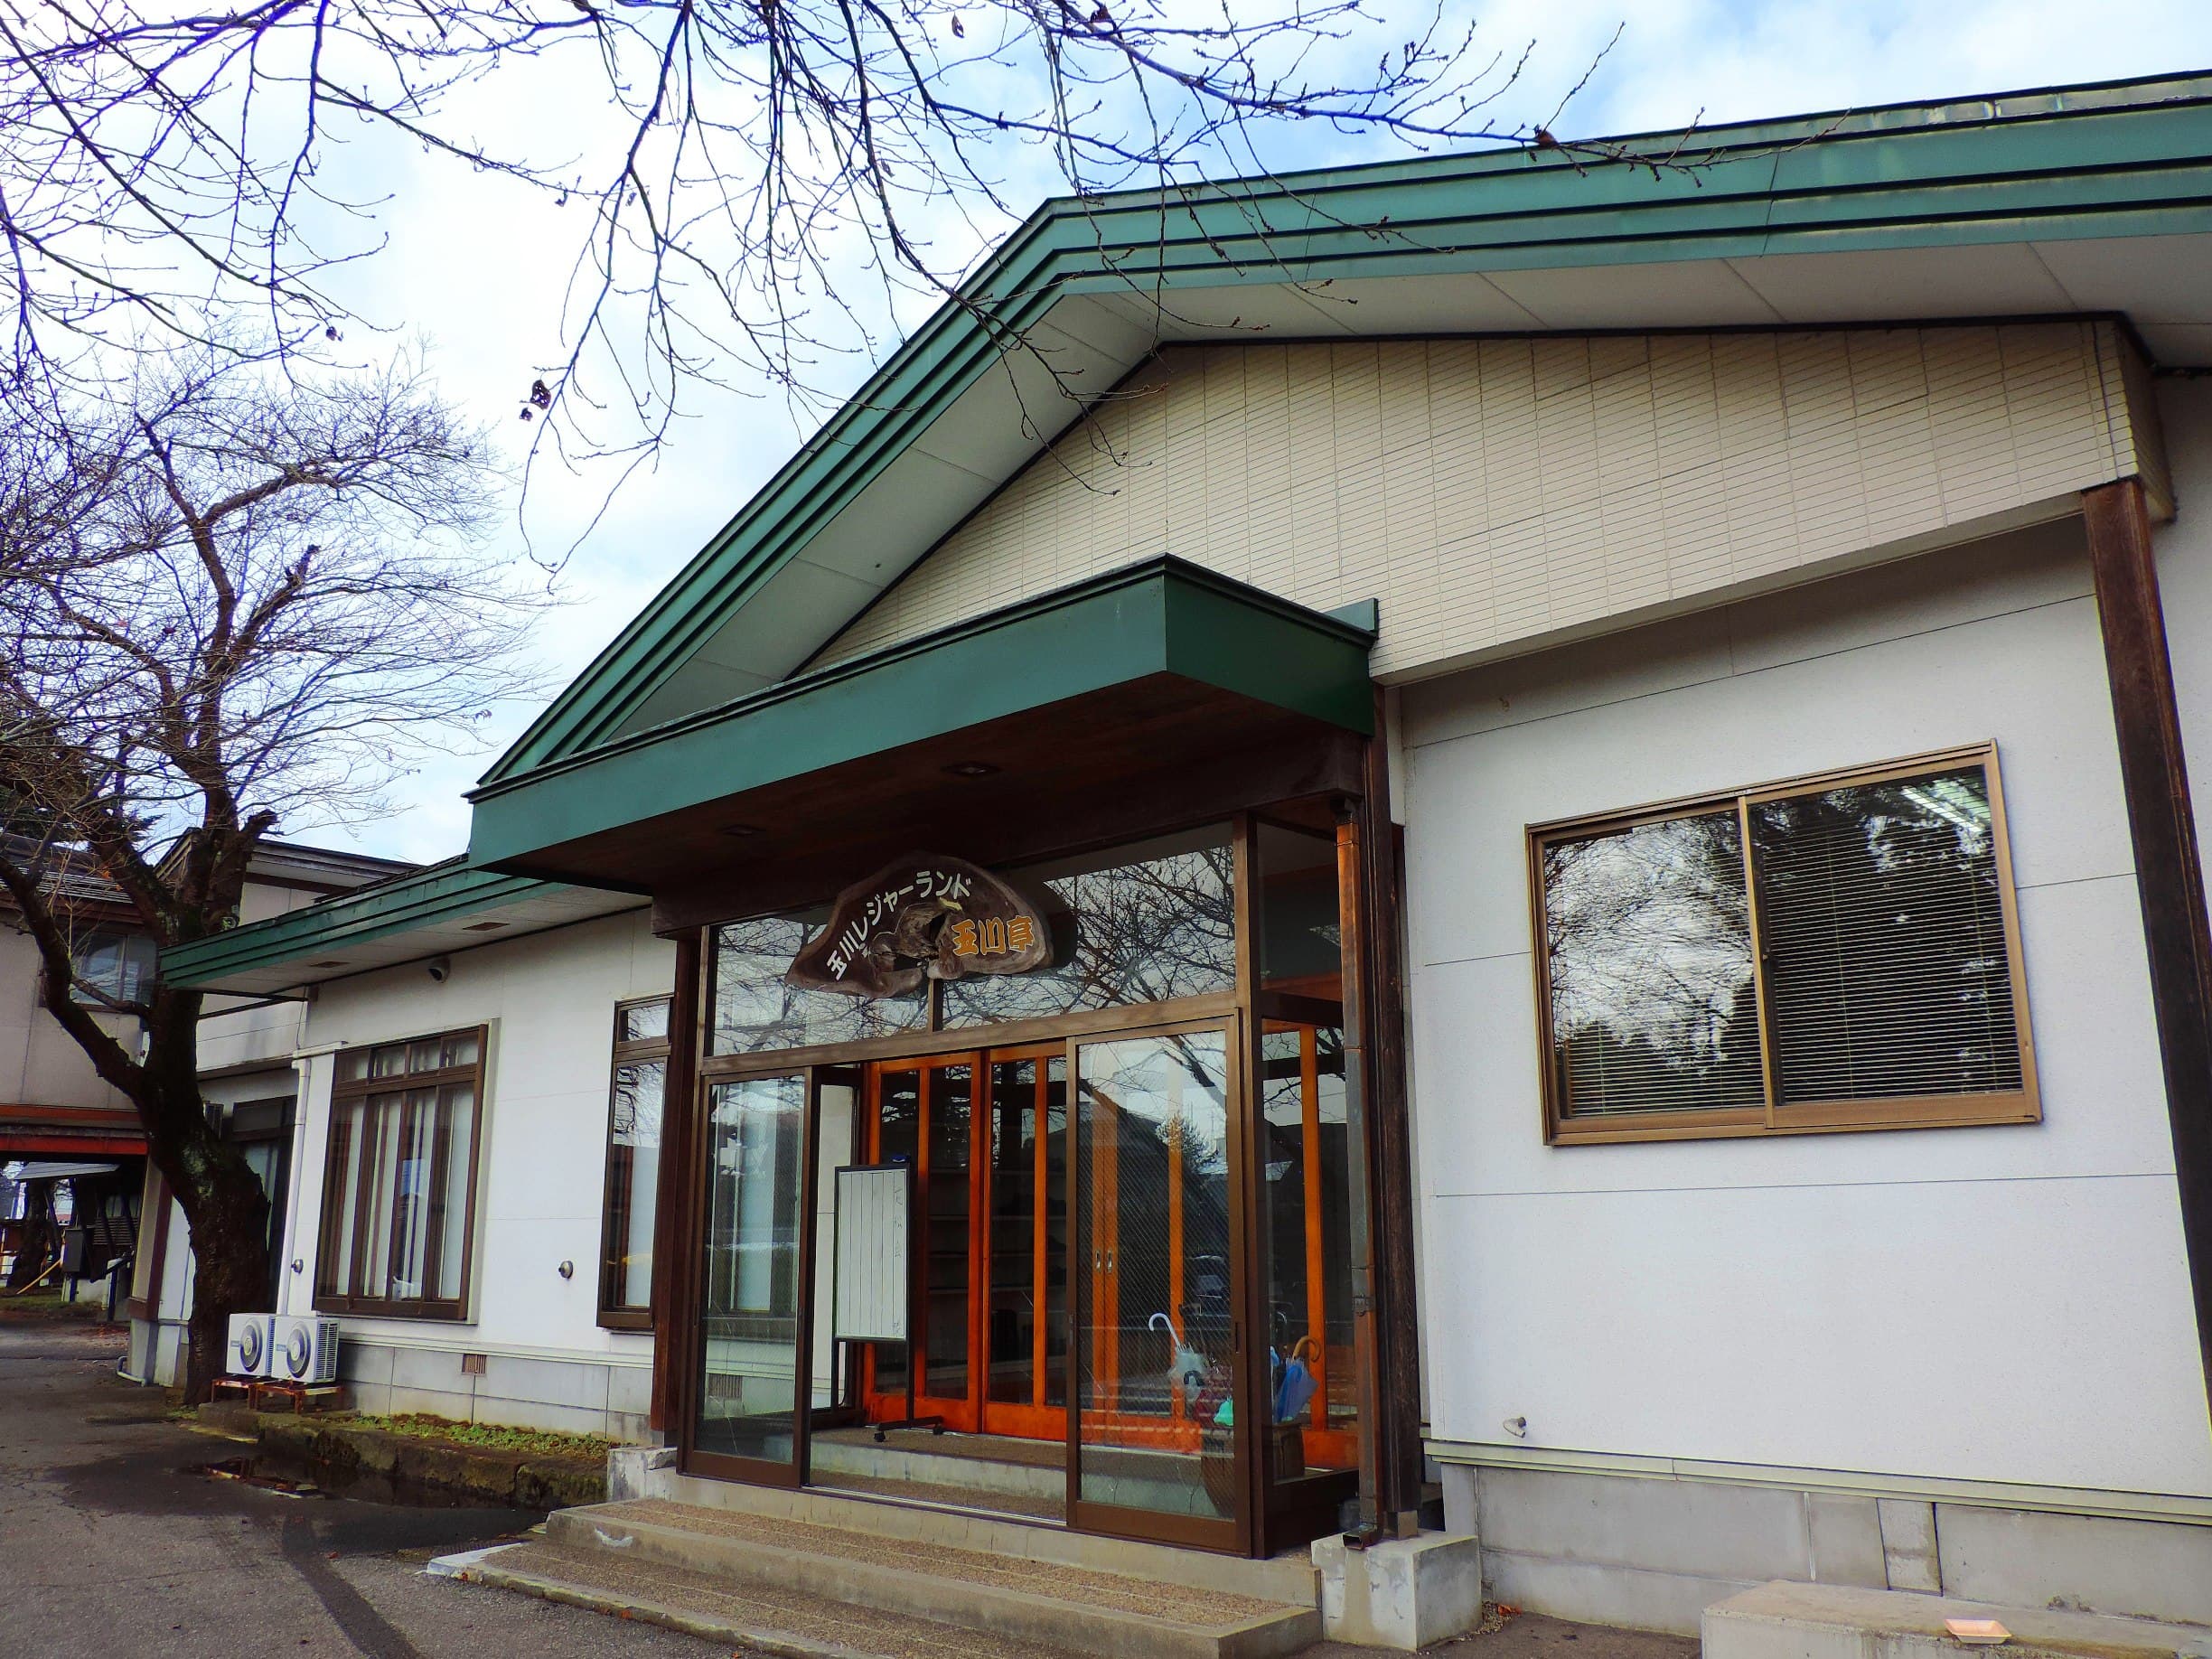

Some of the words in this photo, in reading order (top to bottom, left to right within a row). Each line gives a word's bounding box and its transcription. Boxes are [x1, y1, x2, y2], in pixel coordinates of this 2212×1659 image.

[827, 870, 971, 980] 玉川レジャーランド
[951, 914, 1035, 956] 玉川亭
